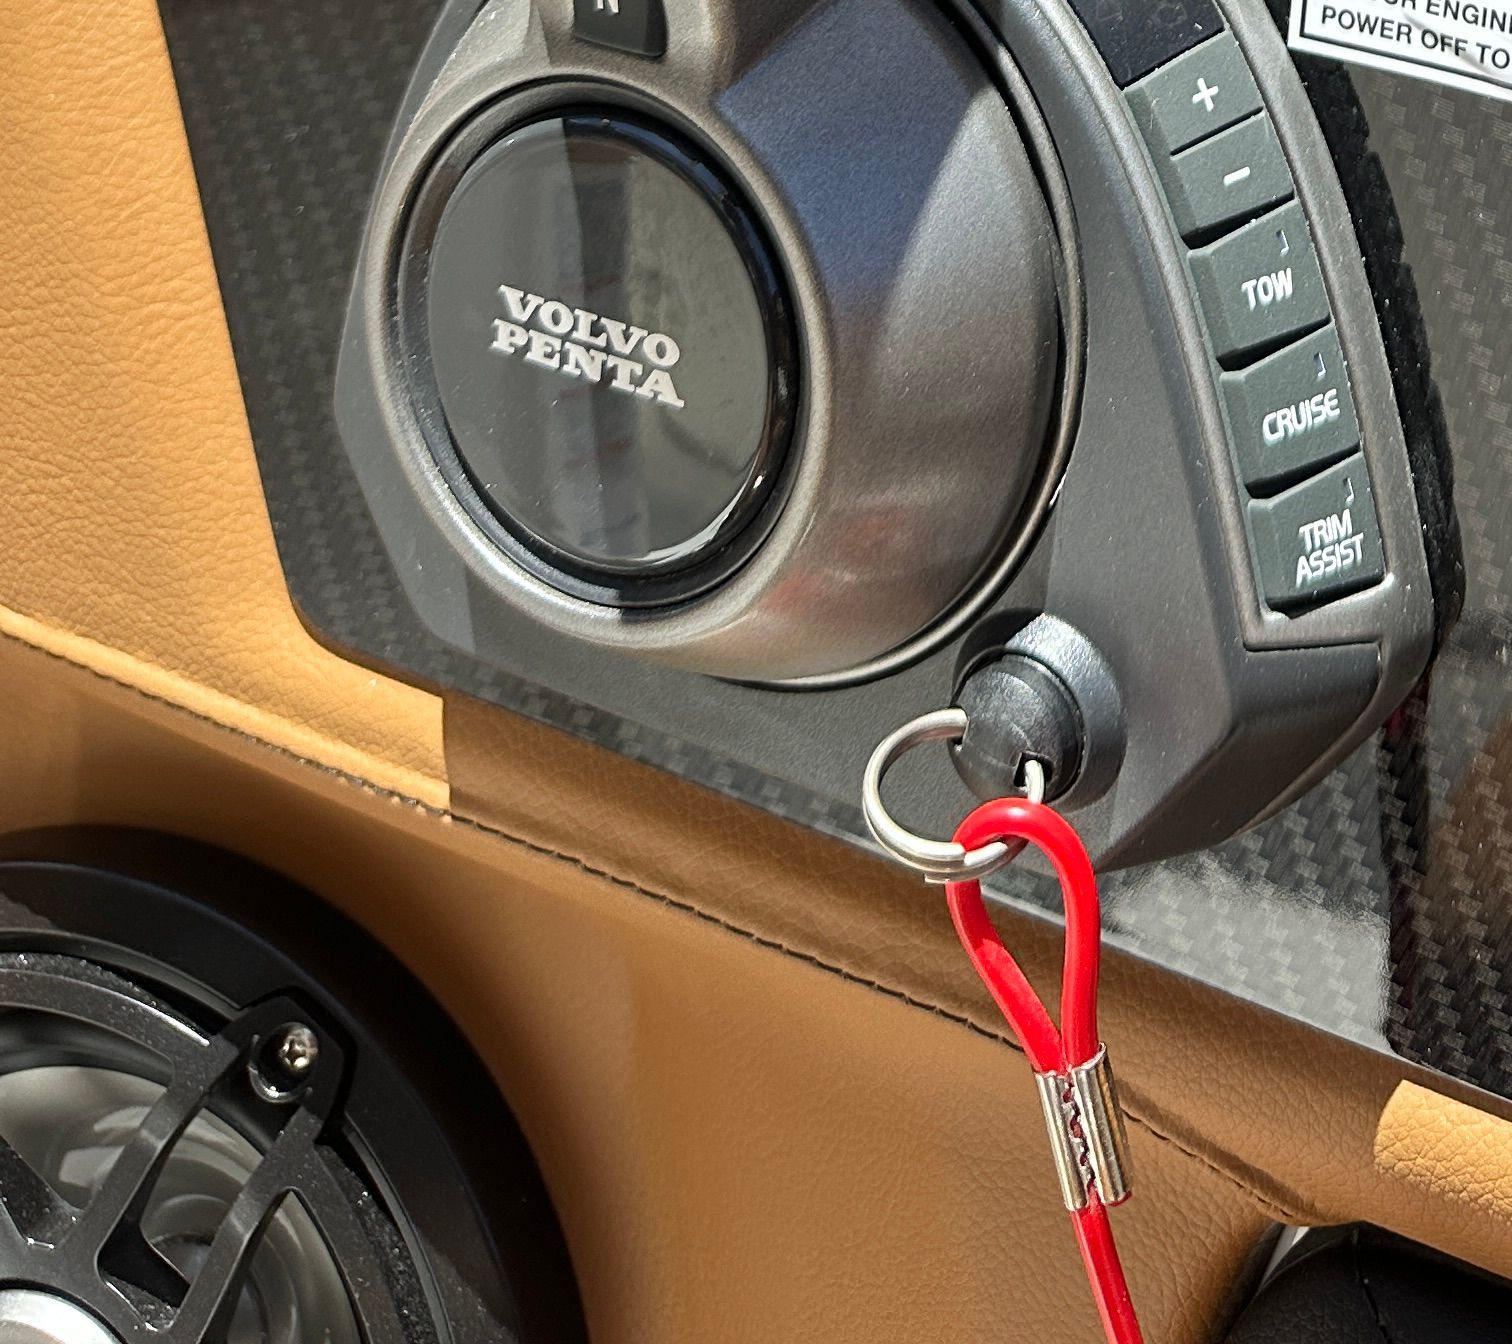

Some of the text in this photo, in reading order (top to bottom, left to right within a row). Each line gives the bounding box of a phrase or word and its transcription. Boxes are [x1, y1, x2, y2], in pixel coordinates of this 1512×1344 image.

[1322, 5, 1412, 45] POWER
[1420, 29, 1468, 58] OFF
[1475, 42, 1510, 70] TO
[1241, 268, 1294, 310] TOW
[499, 285, 681, 365] VOLVO
[490, 320, 686, 407] PENTA
[1262, 388, 1341, 446] CRUISE
[1299, 509, 1352, 554] TRIM
[1296, 533, 1365, 589] ASSIST
